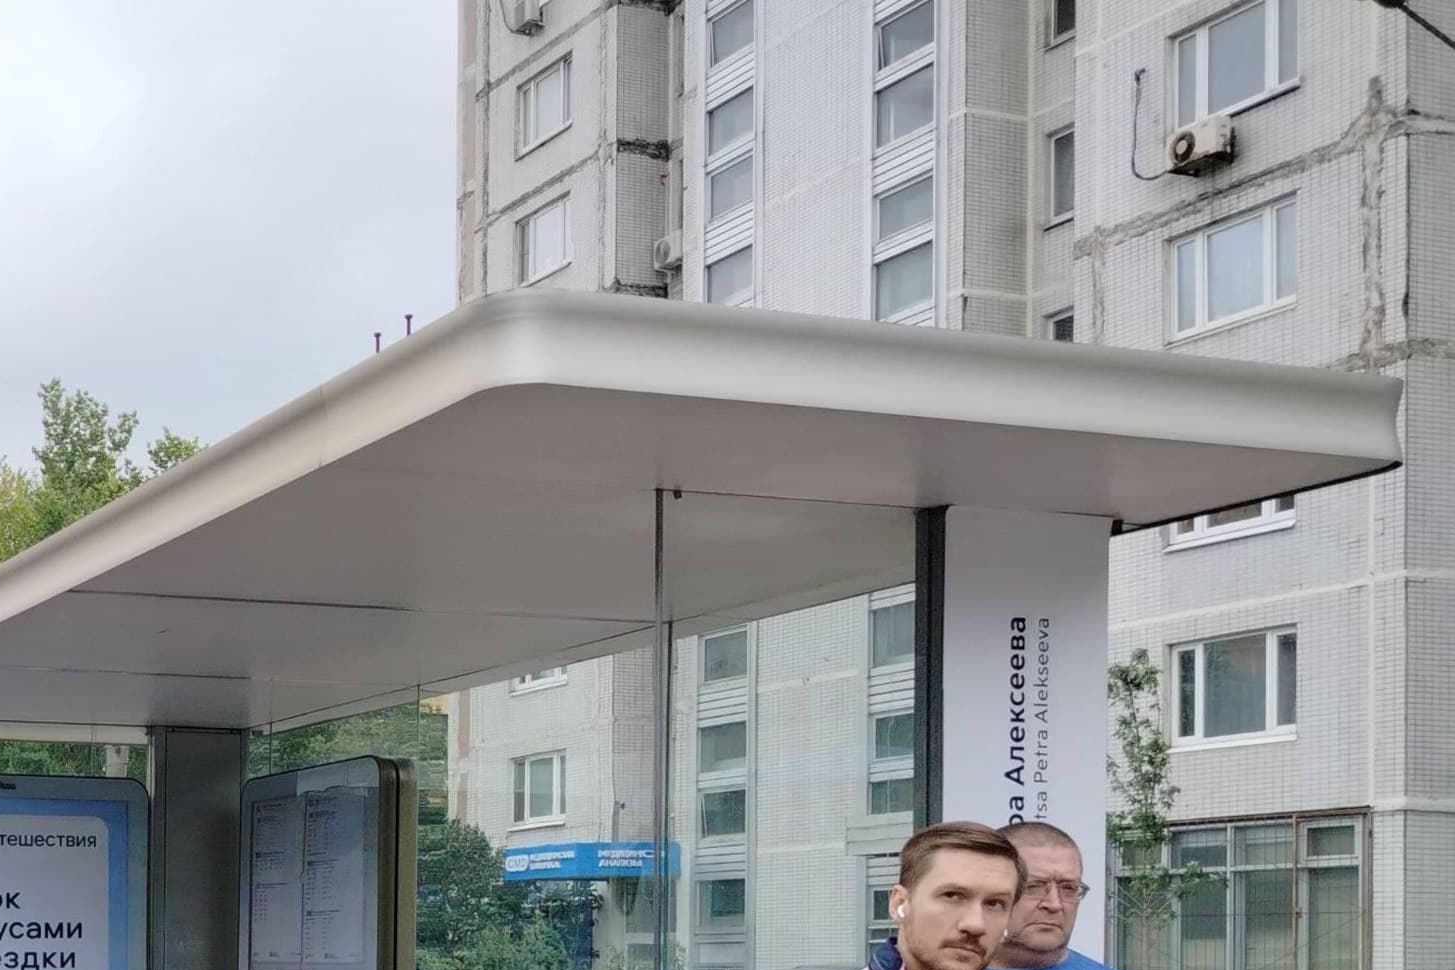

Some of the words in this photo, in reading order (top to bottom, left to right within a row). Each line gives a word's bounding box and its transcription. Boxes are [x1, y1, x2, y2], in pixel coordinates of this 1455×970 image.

[1004, 616, 1026, 786] Алексеева
[1033, 618, 1050, 723] Alekseeva
[1033, 730, 1048, 784] Petra
